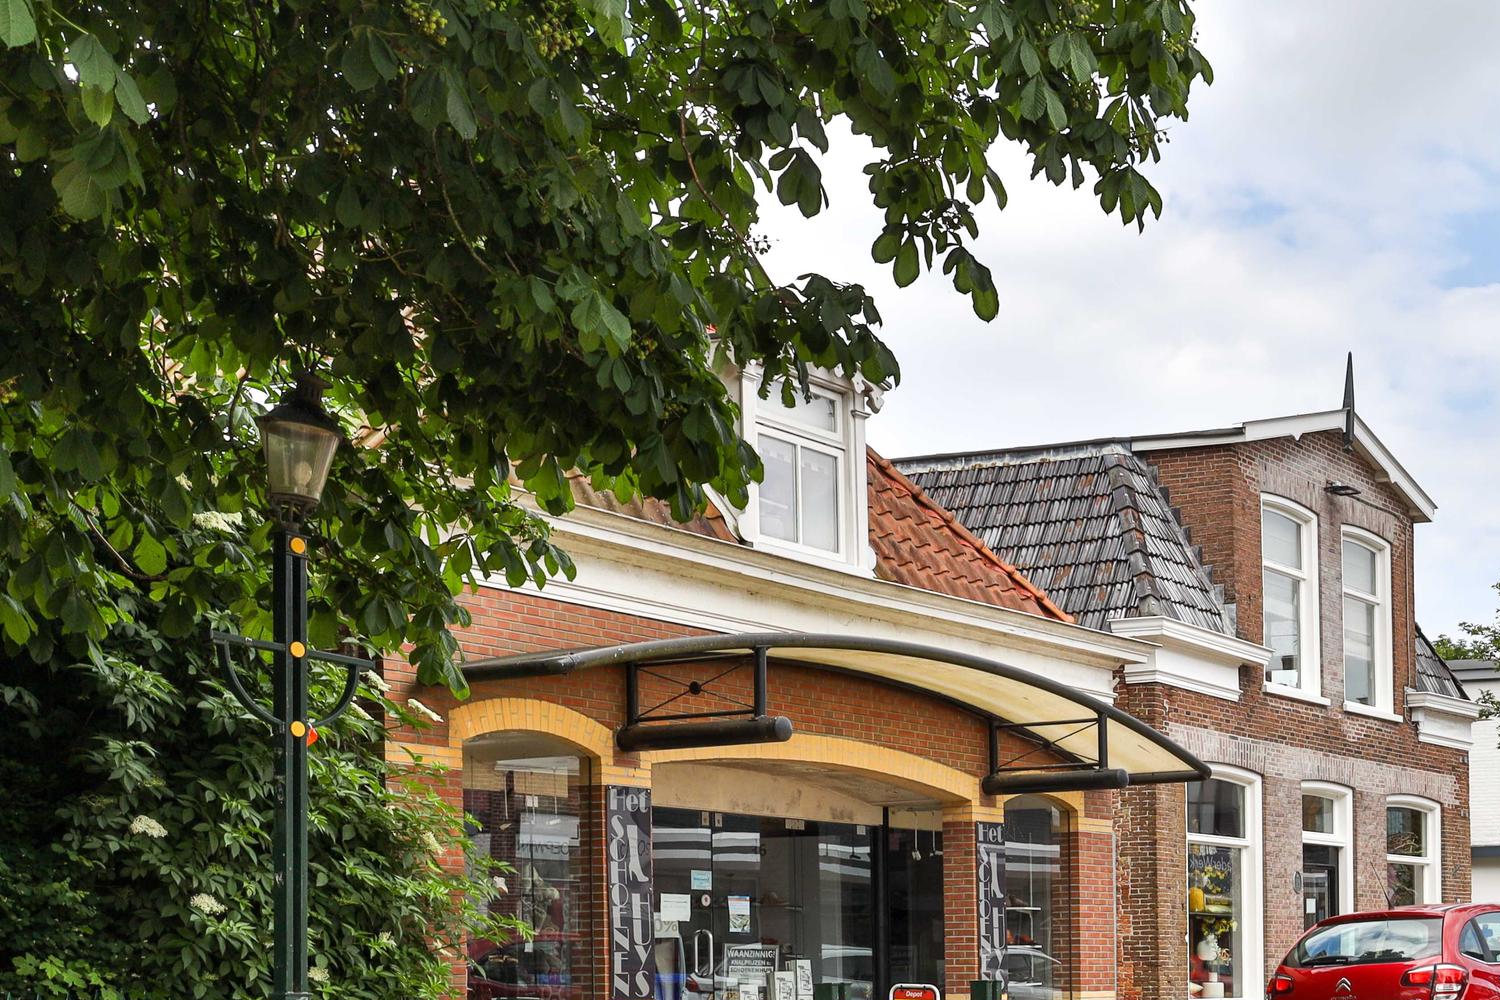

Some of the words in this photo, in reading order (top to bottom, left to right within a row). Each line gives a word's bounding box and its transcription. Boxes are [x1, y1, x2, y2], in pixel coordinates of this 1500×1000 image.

[609, 788, 650, 813] Het
[978, 824, 1004, 843] Het
[609, 814, 631, 998] SCHOENEN
[631, 893, 651, 998] HUYS
[905, 990, 923, 998] Depot
